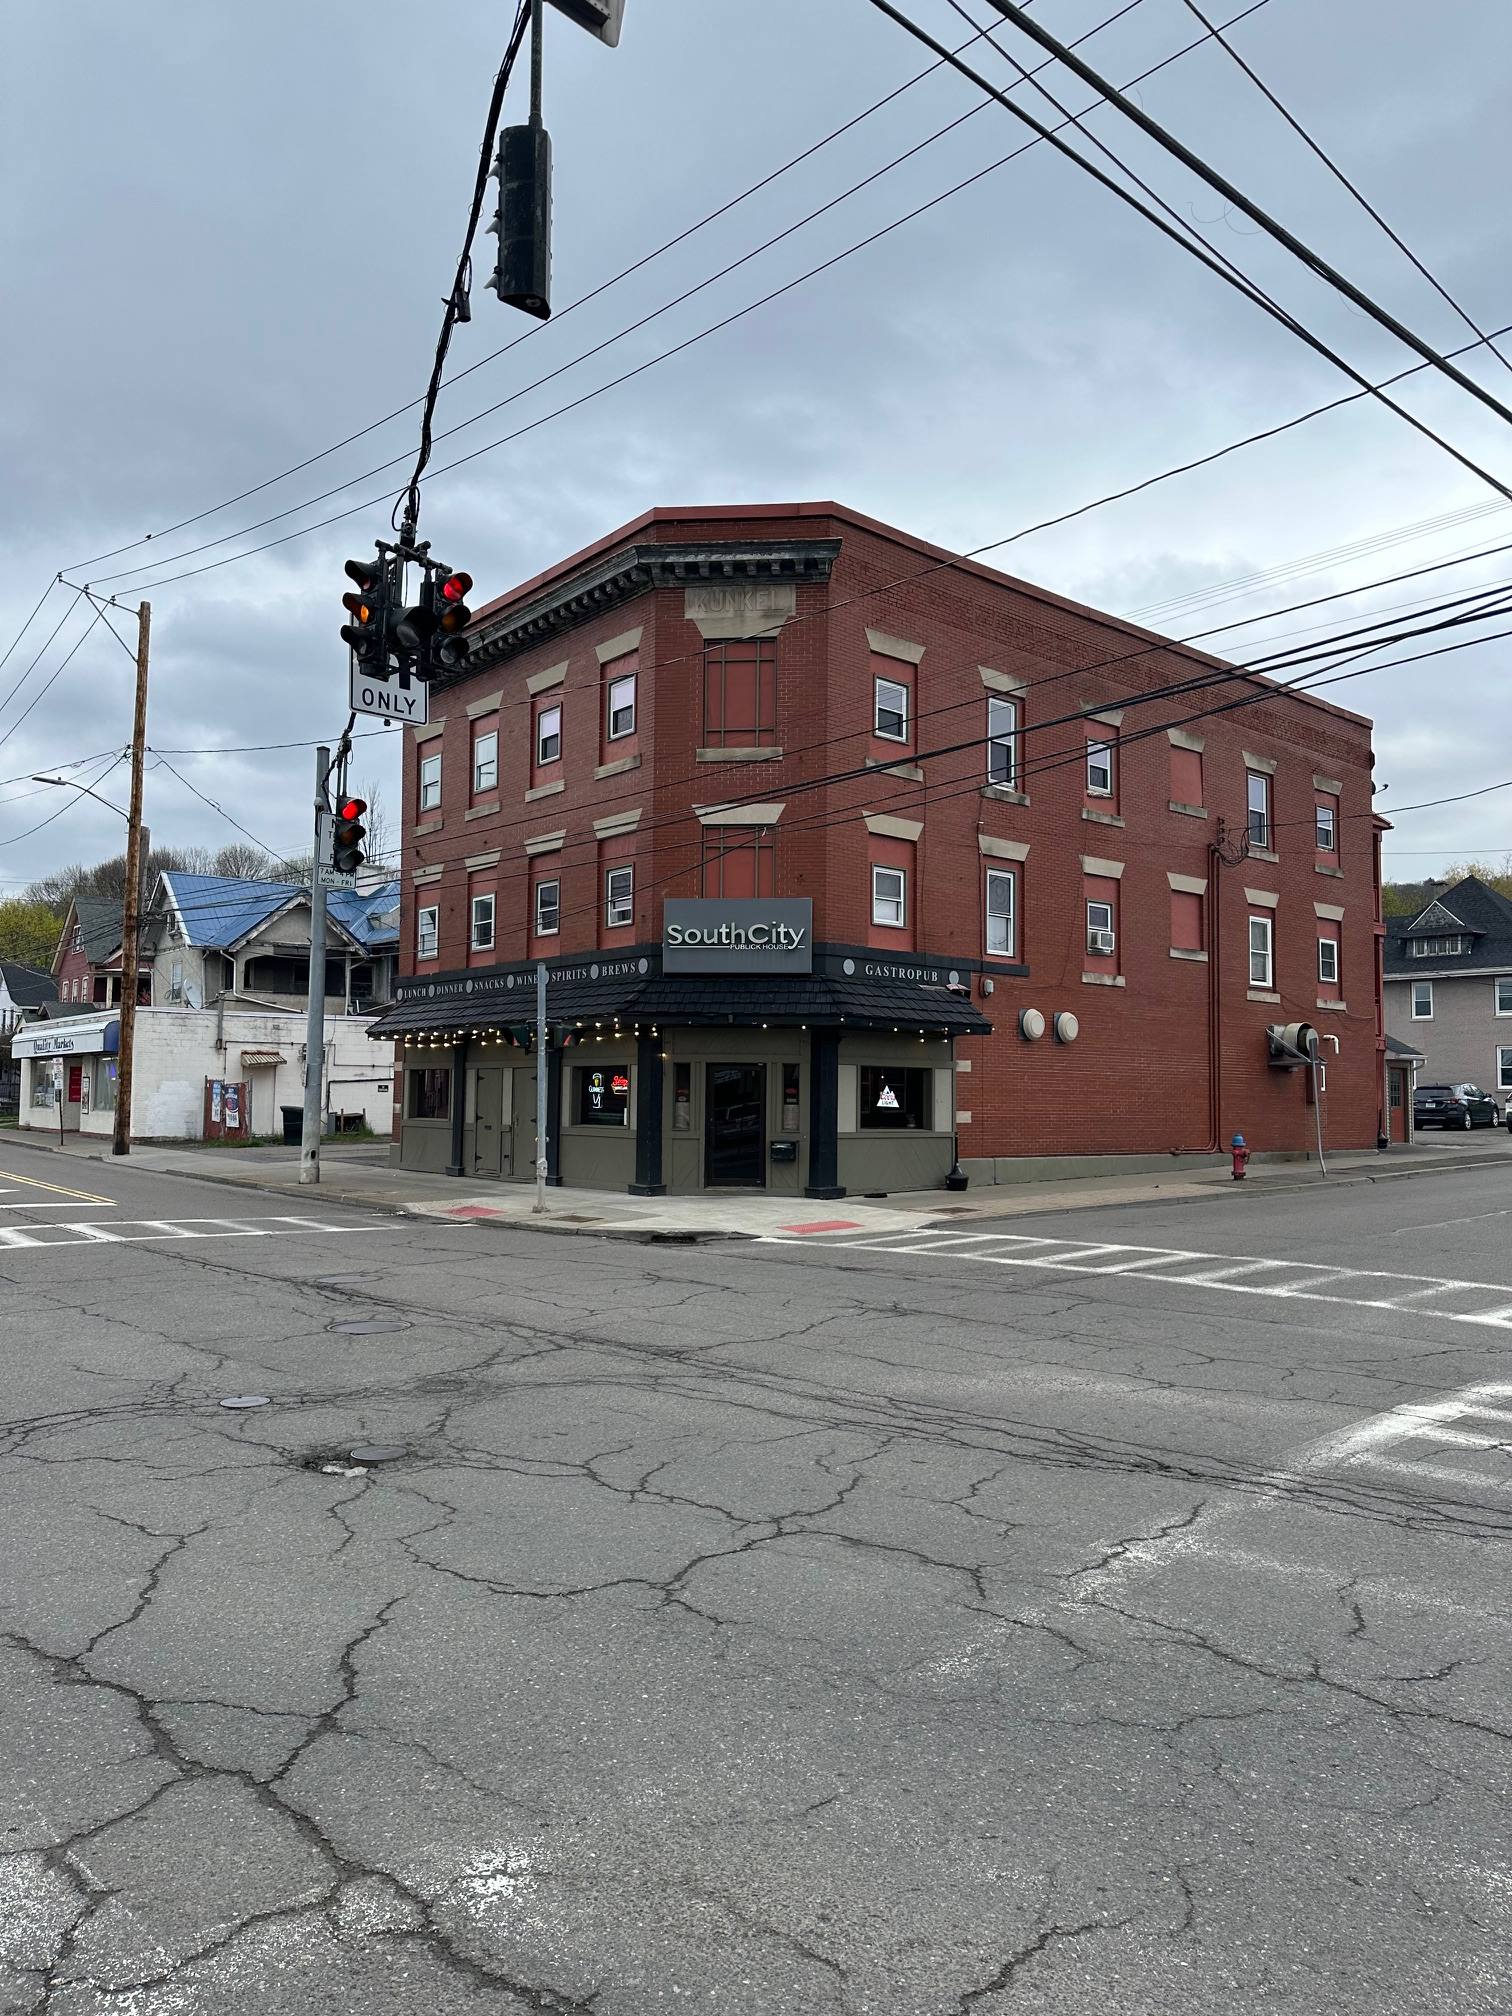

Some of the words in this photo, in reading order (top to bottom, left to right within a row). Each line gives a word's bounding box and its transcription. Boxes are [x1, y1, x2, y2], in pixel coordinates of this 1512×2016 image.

[694, 590, 785, 612] KUNKEL
[362, 688, 417, 715] ONLY
[667, 921, 805, 950] SouthCity
[404, 987, 426, 998] LUNCH
[436, 983, 463, 995] DINNER
[474, 979, 504, 991] SNACKS
[551, 968, 587, 982] SPIRITS
[602, 962, 636, 977] BREWS
[865, 964, 938, 982] GASTROPUB
